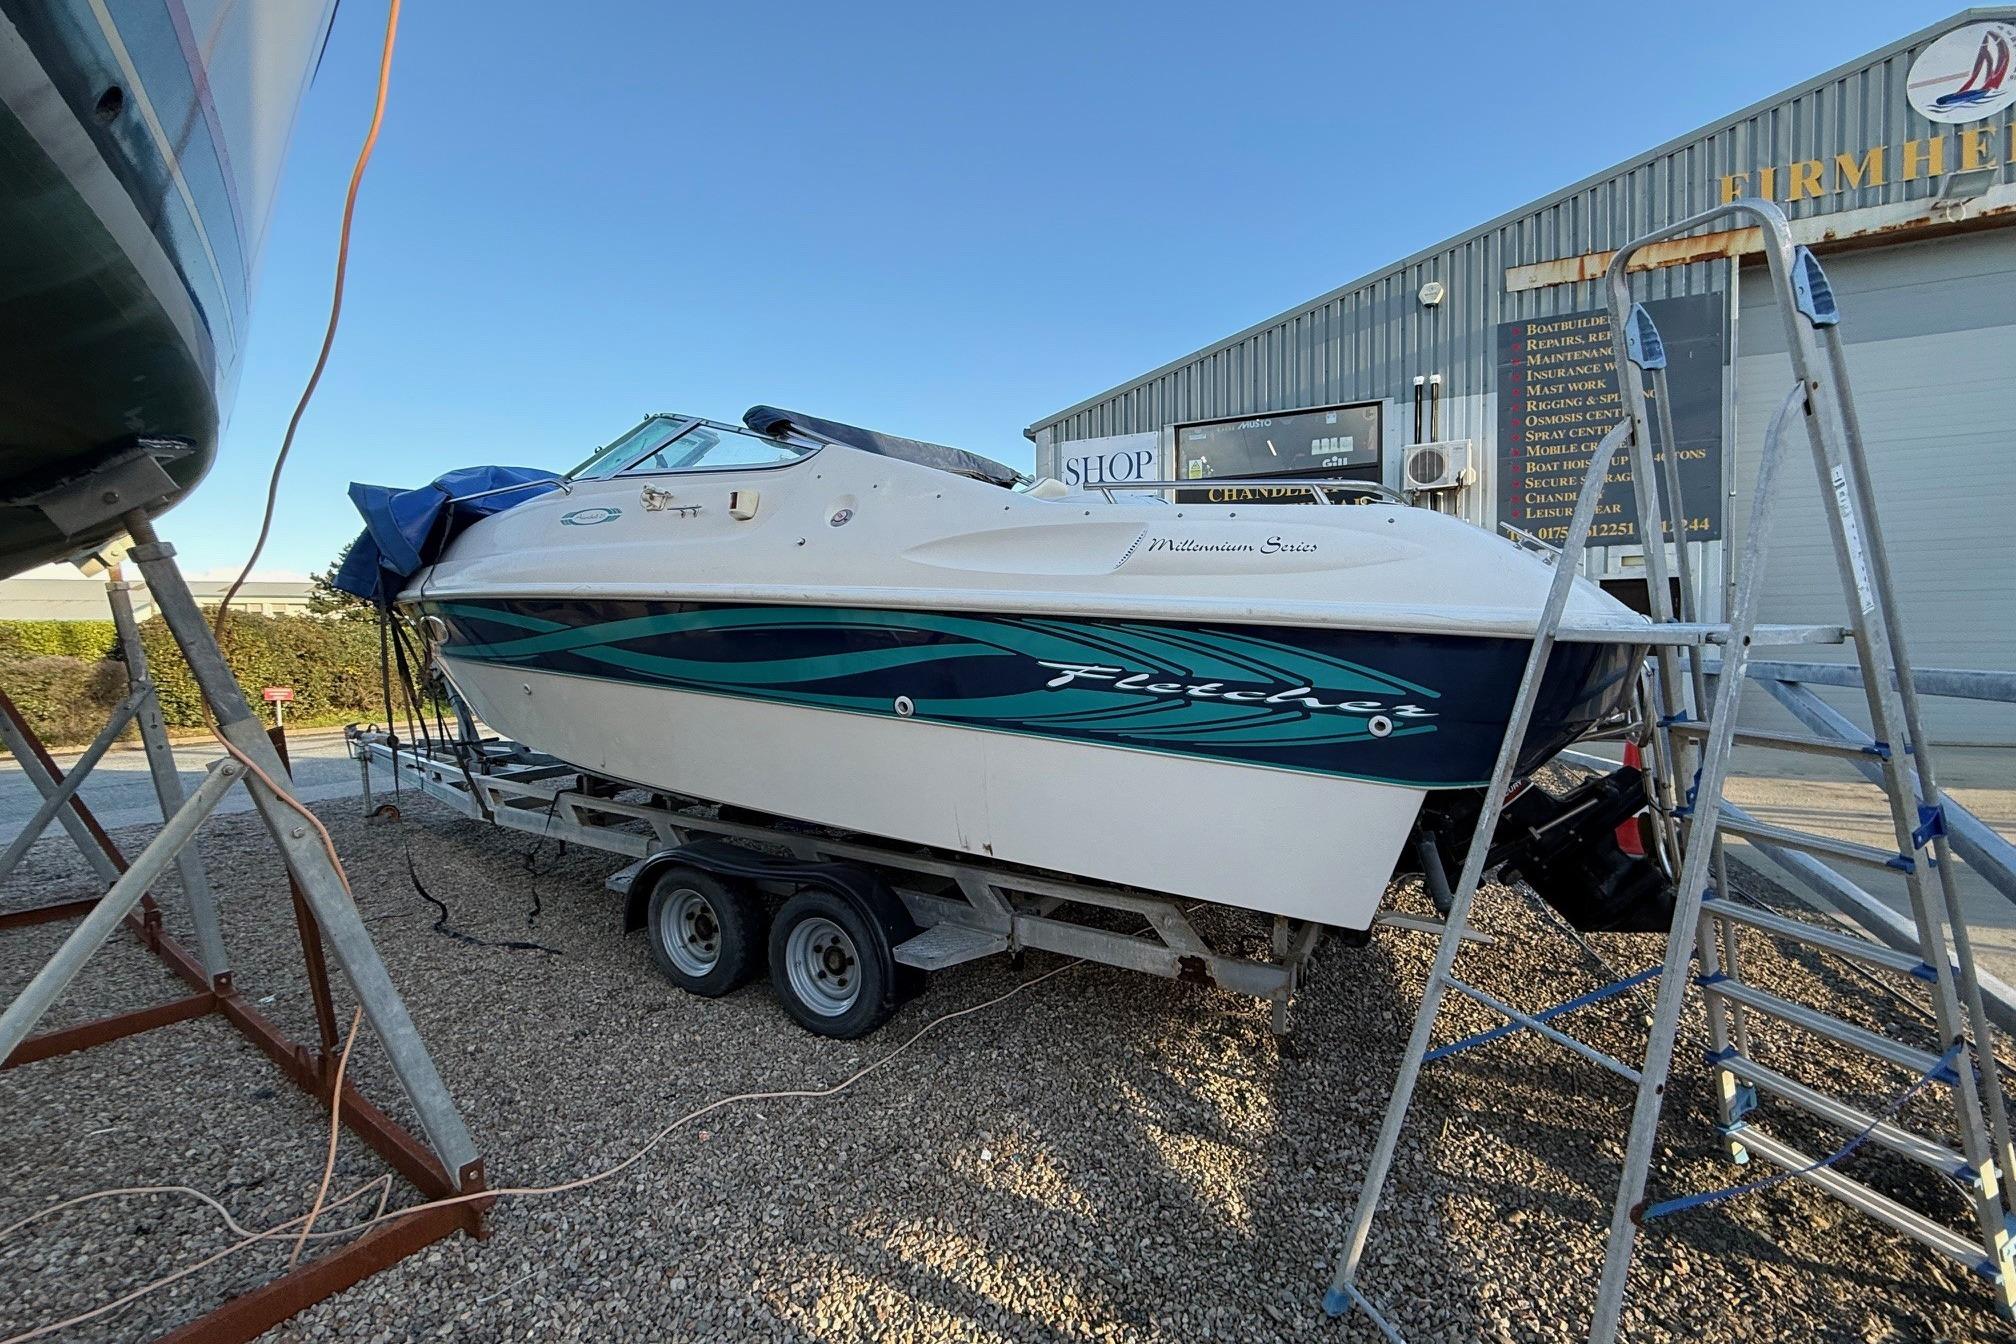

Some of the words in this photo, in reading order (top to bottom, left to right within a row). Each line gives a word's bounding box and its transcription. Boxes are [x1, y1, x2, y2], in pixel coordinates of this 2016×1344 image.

[1526, 335, 1585, 351] REPAIRS,
[1526, 346, 1615, 366] MAINTENANC
[1526, 364, 1601, 381] INSURANCE
[1526, 384, 1564, 397] MAST
[1568, 379, 1606, 392] WORK
[1526, 397, 1583, 412] RIGGING
[1586, 396, 1597, 406] &
[1237, 419, 1272, 430] MUSTO
[1525, 412, 1583, 427] OSMOSIS
[1586, 408, 1625, 421] CENT
[1525, 430, 1566, 442] SPRAY
[1569, 424, 1614, 437] CENTR
[1526, 443, 1578, 457] MOBILE
[1065, 449, 1153, 486] SHOP
[1322, 456, 1348, 468] Gill
[1526, 461, 1560, 473] BOAT
[1563, 459, 1592, 470] HOIS
[1611, 456, 1629, 466] UP
[1525, 476, 1577, 489] SECURE
[1580, 472, 1634, 485] SRAG
[1208, 478, 1343, 503] CHANDL
[1526, 507, 1574, 519] LEISUR
[1594, 504, 1622, 515] EAR
[1538, 526, 1570, 540] 0175
[1148, 537, 1254, 554] Millennium
[1260, 536, 1318, 555] Series
[1037, 660, 1440, 717] Fletcher
